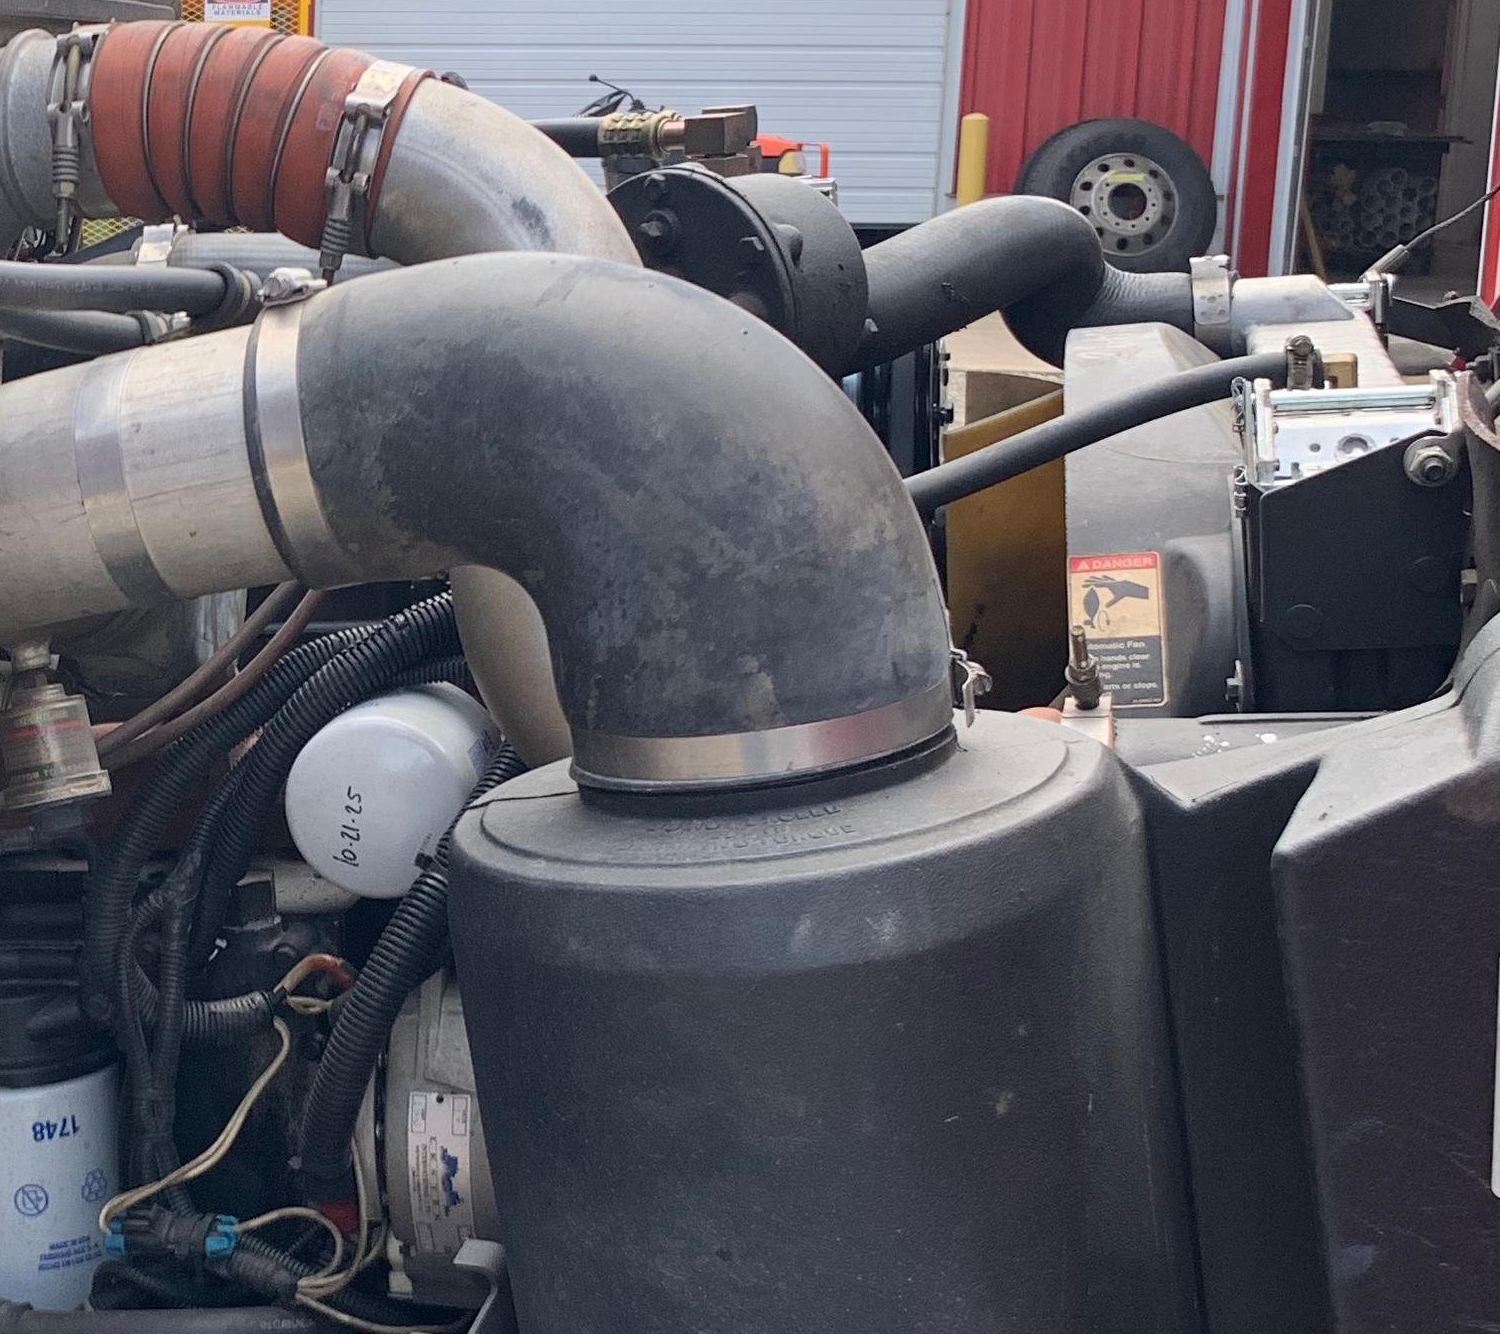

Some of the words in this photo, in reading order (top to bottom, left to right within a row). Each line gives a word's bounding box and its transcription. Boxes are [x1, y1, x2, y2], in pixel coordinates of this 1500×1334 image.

[1091, 556, 1154, 571] DANGER
[1126, 640, 1146, 649] Fan
[31, 1114, 80, 1142] 1748
